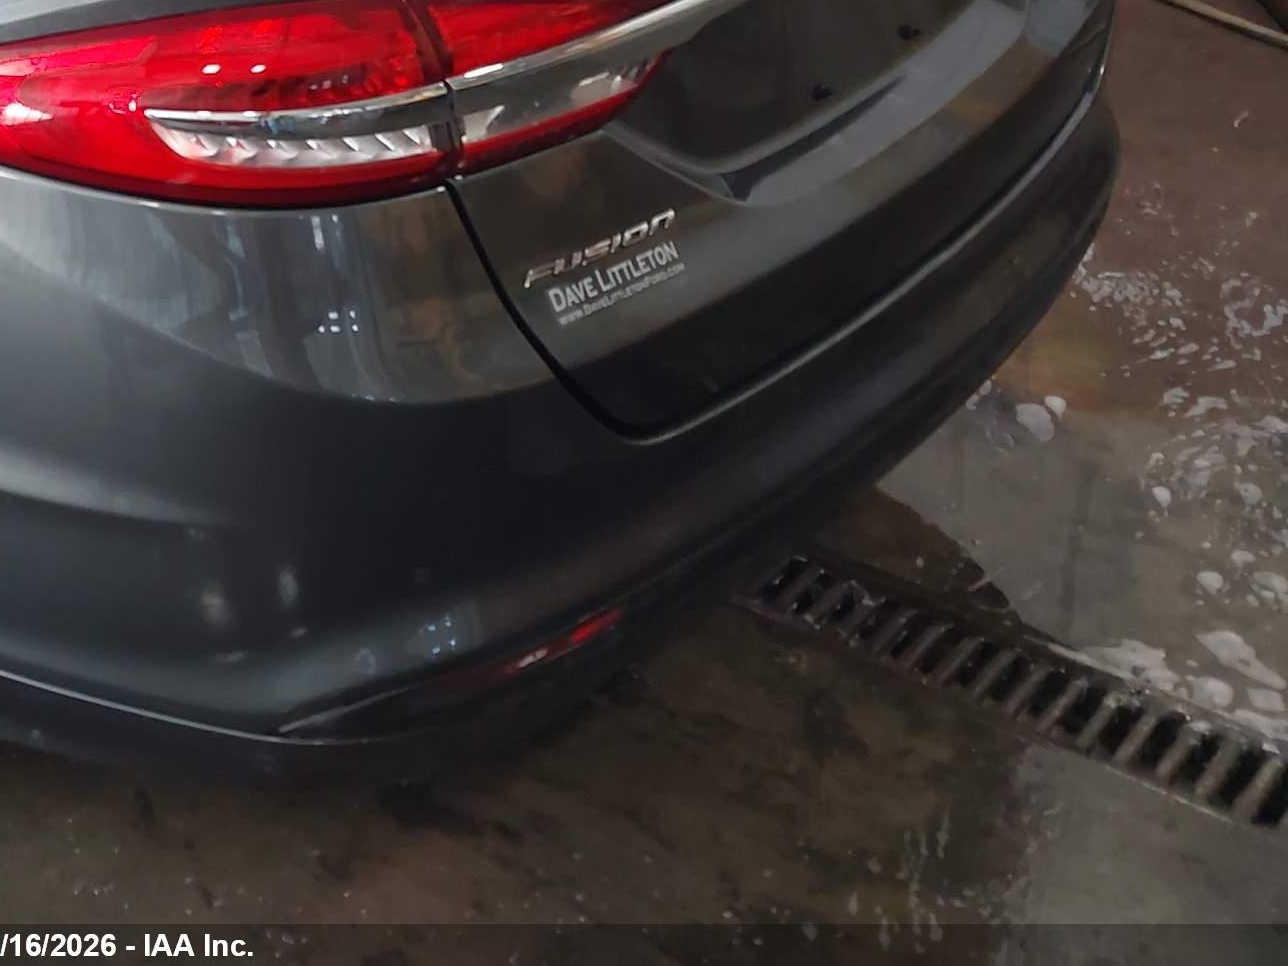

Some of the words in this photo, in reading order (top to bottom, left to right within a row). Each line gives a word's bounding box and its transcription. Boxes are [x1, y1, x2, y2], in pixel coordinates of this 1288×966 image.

[523, 207, 676, 288] FUSION
[548, 277, 598, 313] DAVE
[595, 241, 680, 291] LITTLETON
